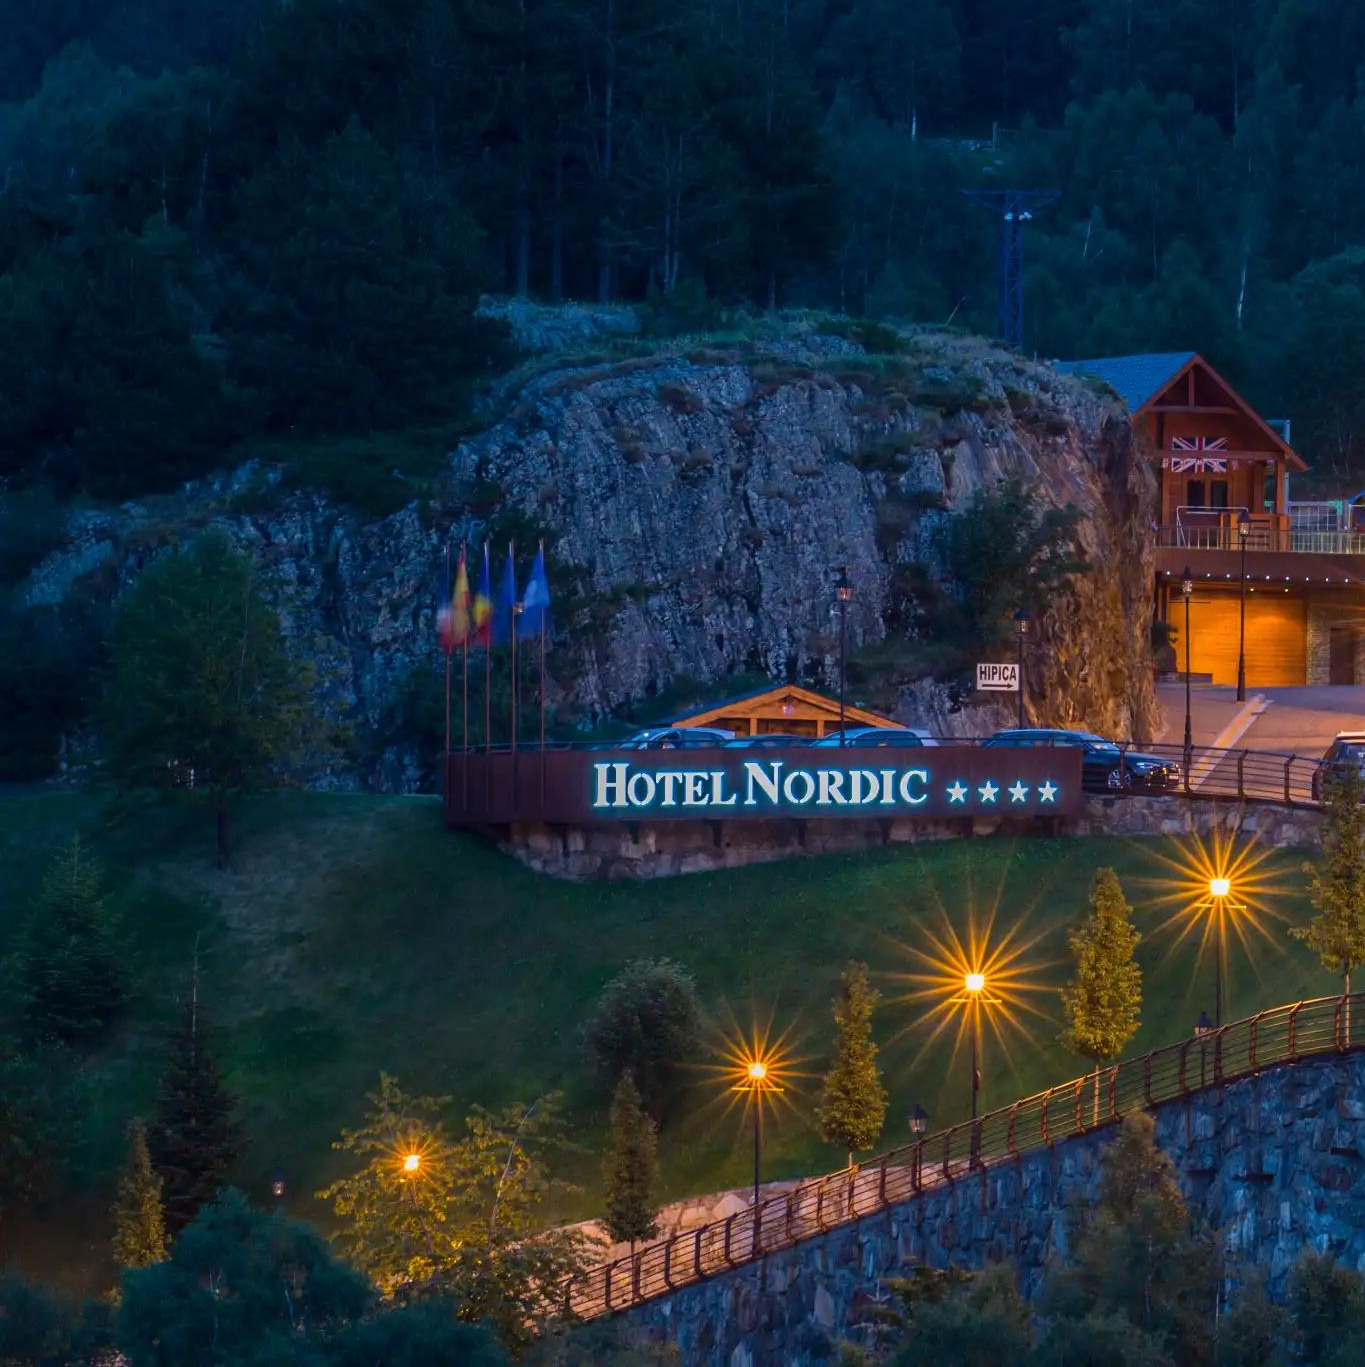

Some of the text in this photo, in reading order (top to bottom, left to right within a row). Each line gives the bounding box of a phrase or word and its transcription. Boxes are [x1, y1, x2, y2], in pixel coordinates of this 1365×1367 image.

[979, 665, 1017, 681] HIPICA
[593, 762, 928, 806] HOTEL NORDIC
